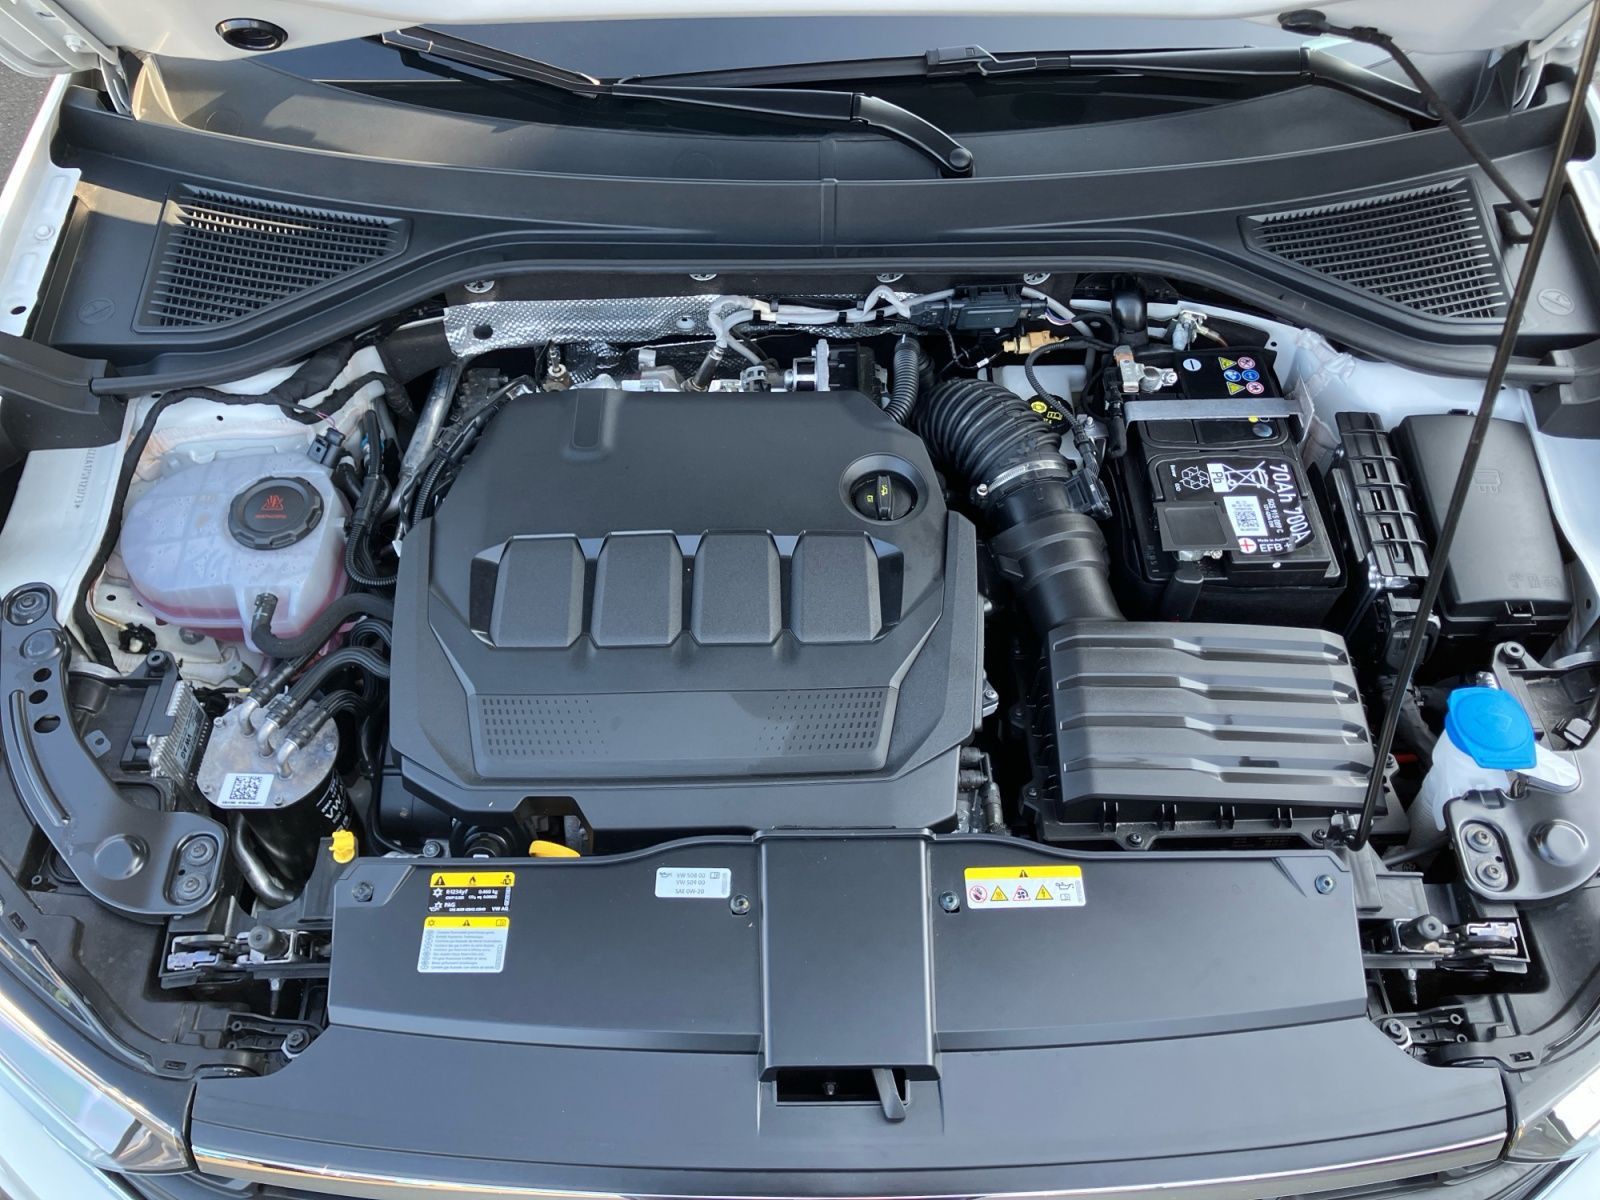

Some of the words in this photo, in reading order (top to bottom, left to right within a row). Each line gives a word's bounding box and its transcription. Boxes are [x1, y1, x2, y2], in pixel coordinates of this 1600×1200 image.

[1211, 471, 1223, 483] Pb
[1269, 463, 1297, 503] 70Ah
[1283, 506, 1311, 543] 700A
[1259, 543, 1283, 552] EFB
